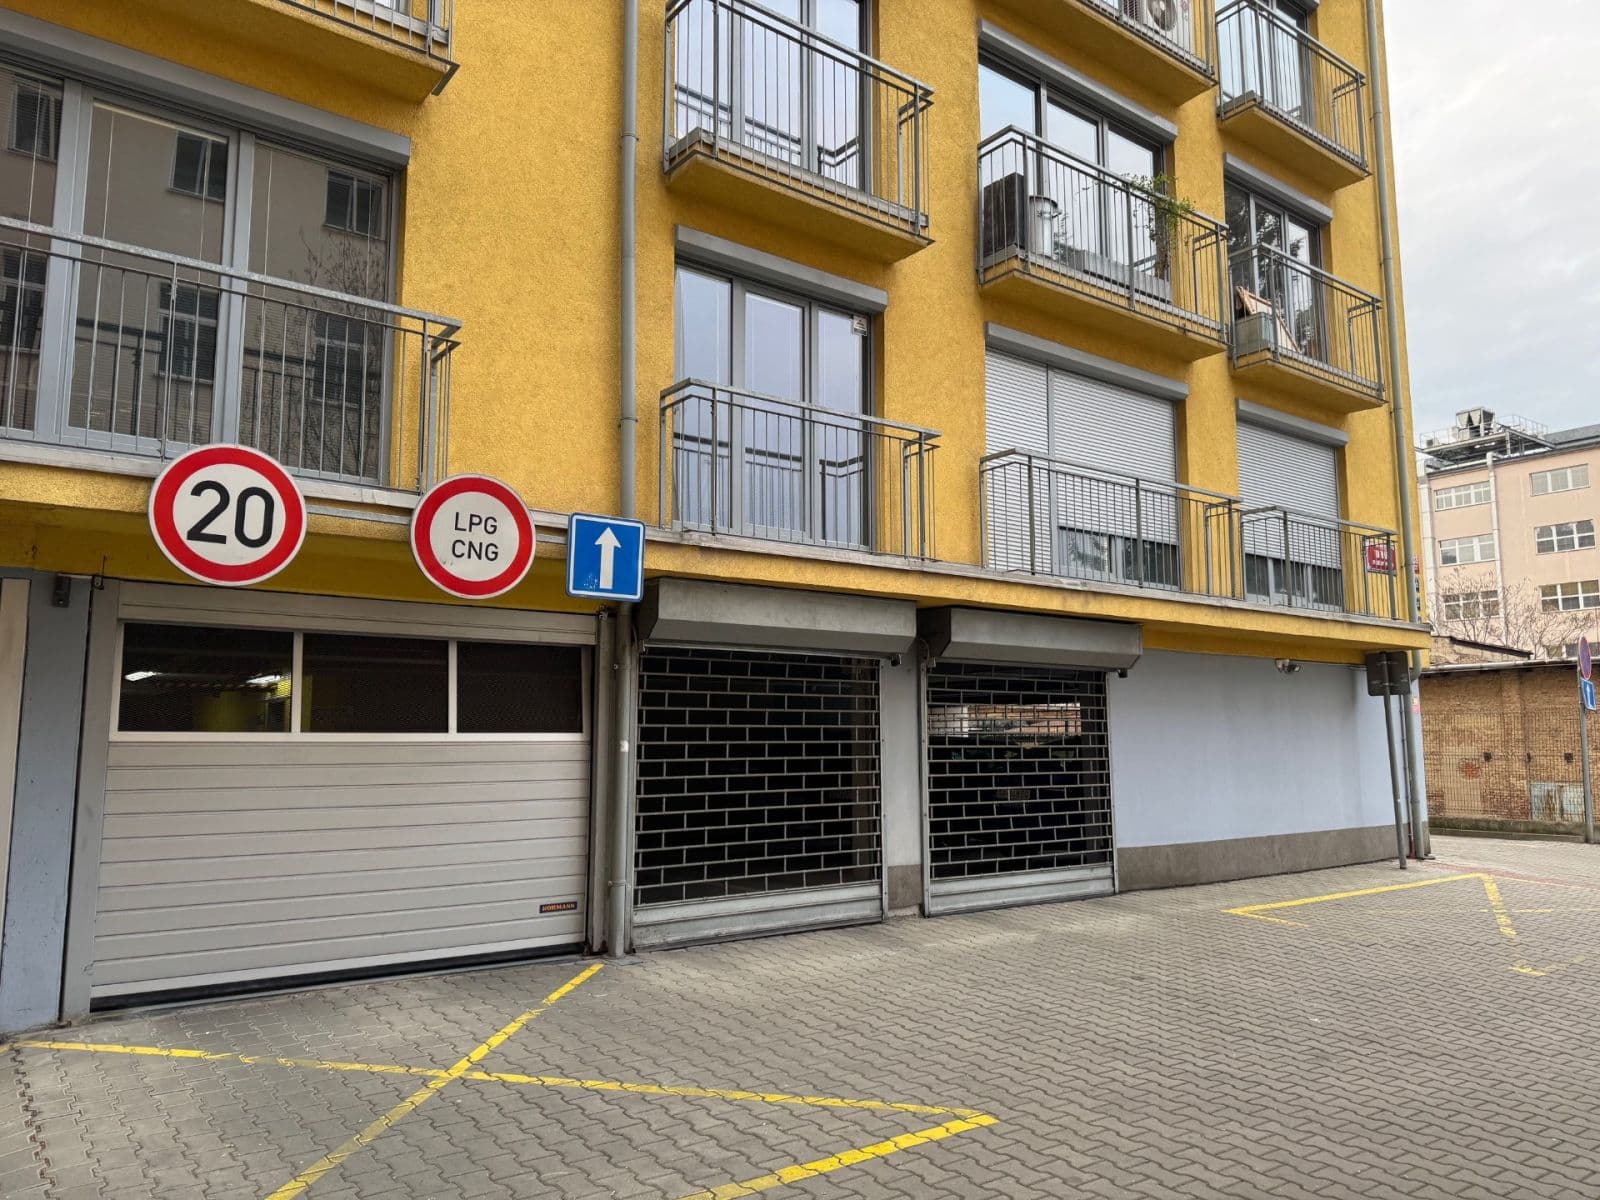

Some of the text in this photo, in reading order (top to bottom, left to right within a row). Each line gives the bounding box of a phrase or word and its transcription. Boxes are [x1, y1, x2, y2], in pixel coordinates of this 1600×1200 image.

[187, 480, 274, 548] 20
[454, 512, 498, 535] LPG
[452, 539, 499, 562] CNG
